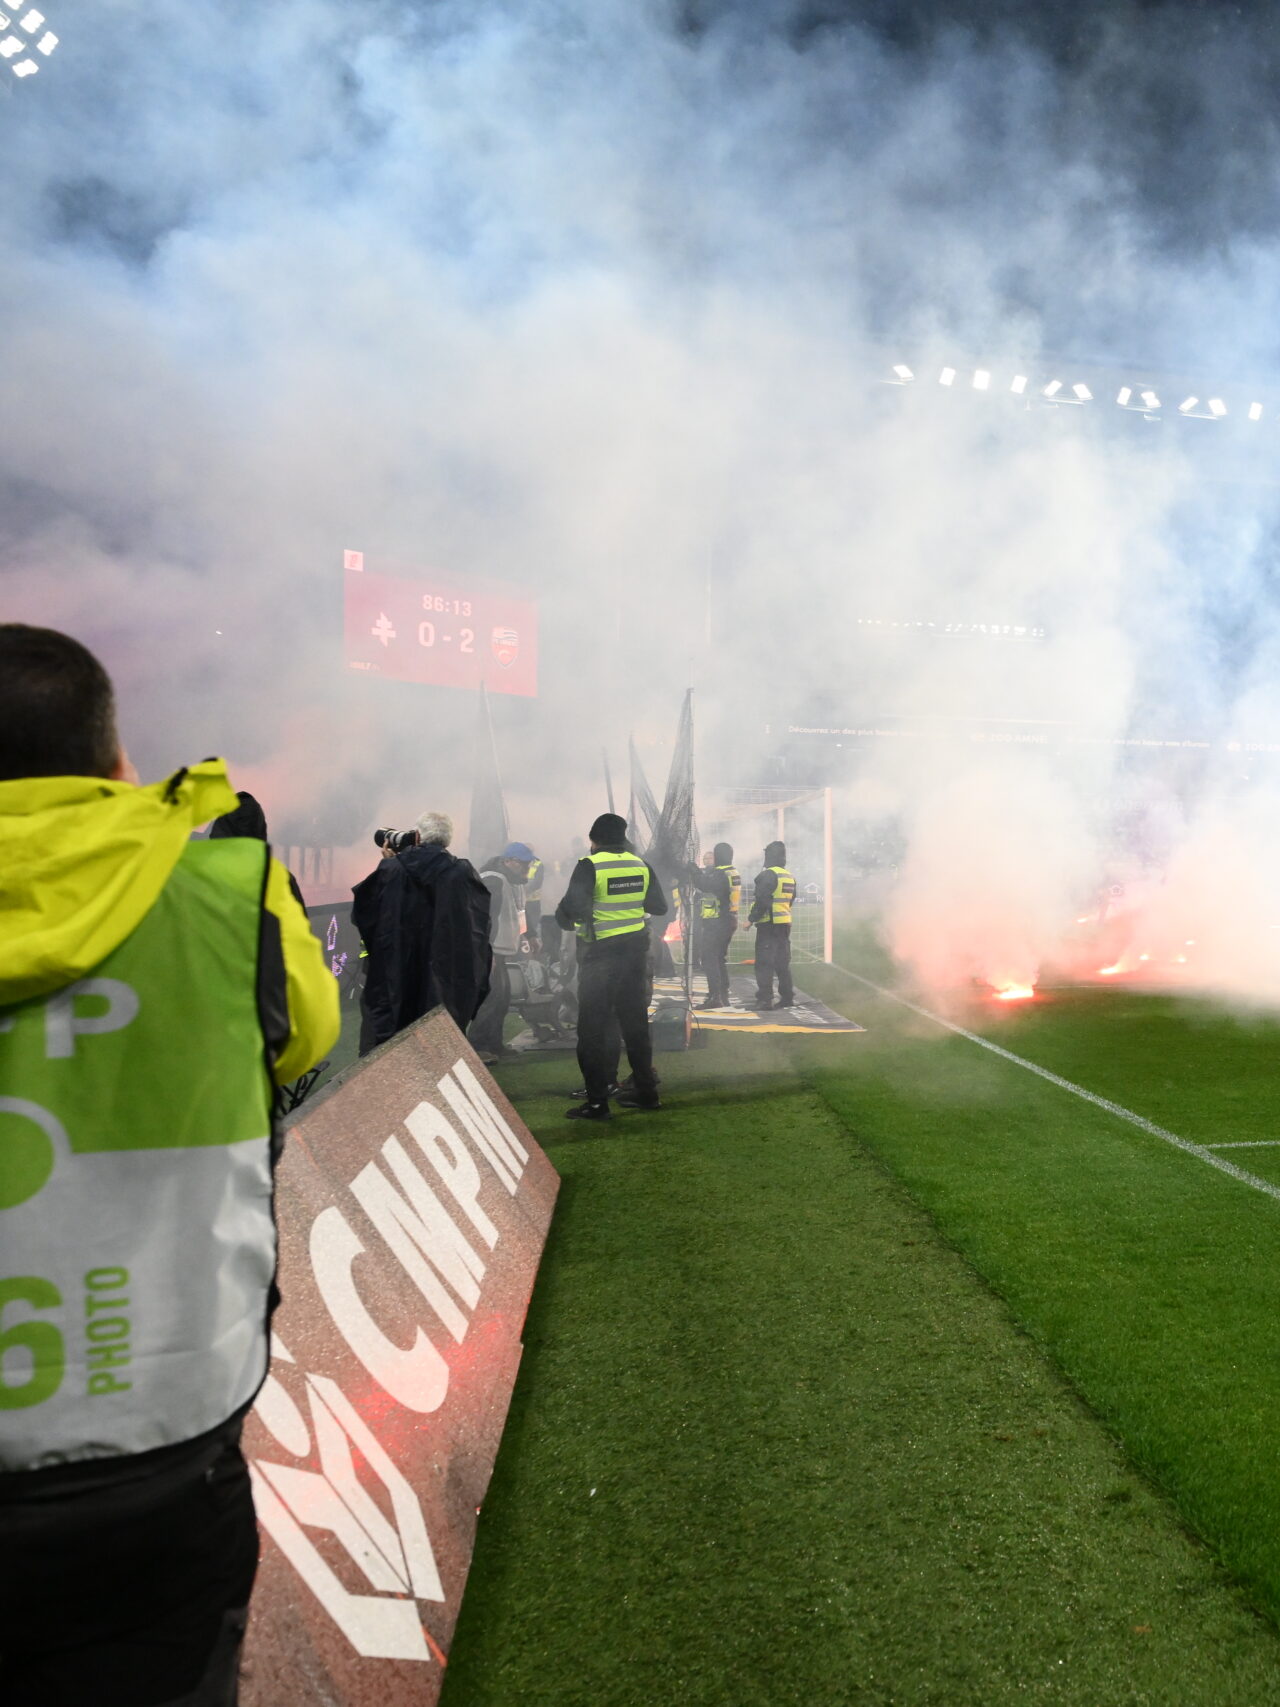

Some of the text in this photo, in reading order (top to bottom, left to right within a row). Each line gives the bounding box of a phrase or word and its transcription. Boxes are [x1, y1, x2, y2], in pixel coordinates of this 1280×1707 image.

[418, 621, 434, 647] 0
[459, 628, 475, 653] 2
[422, 594, 472, 617] 86:13
[309, 1058, 530, 1414] CMPM
[83, 1266, 133, 1395] PHOTO
